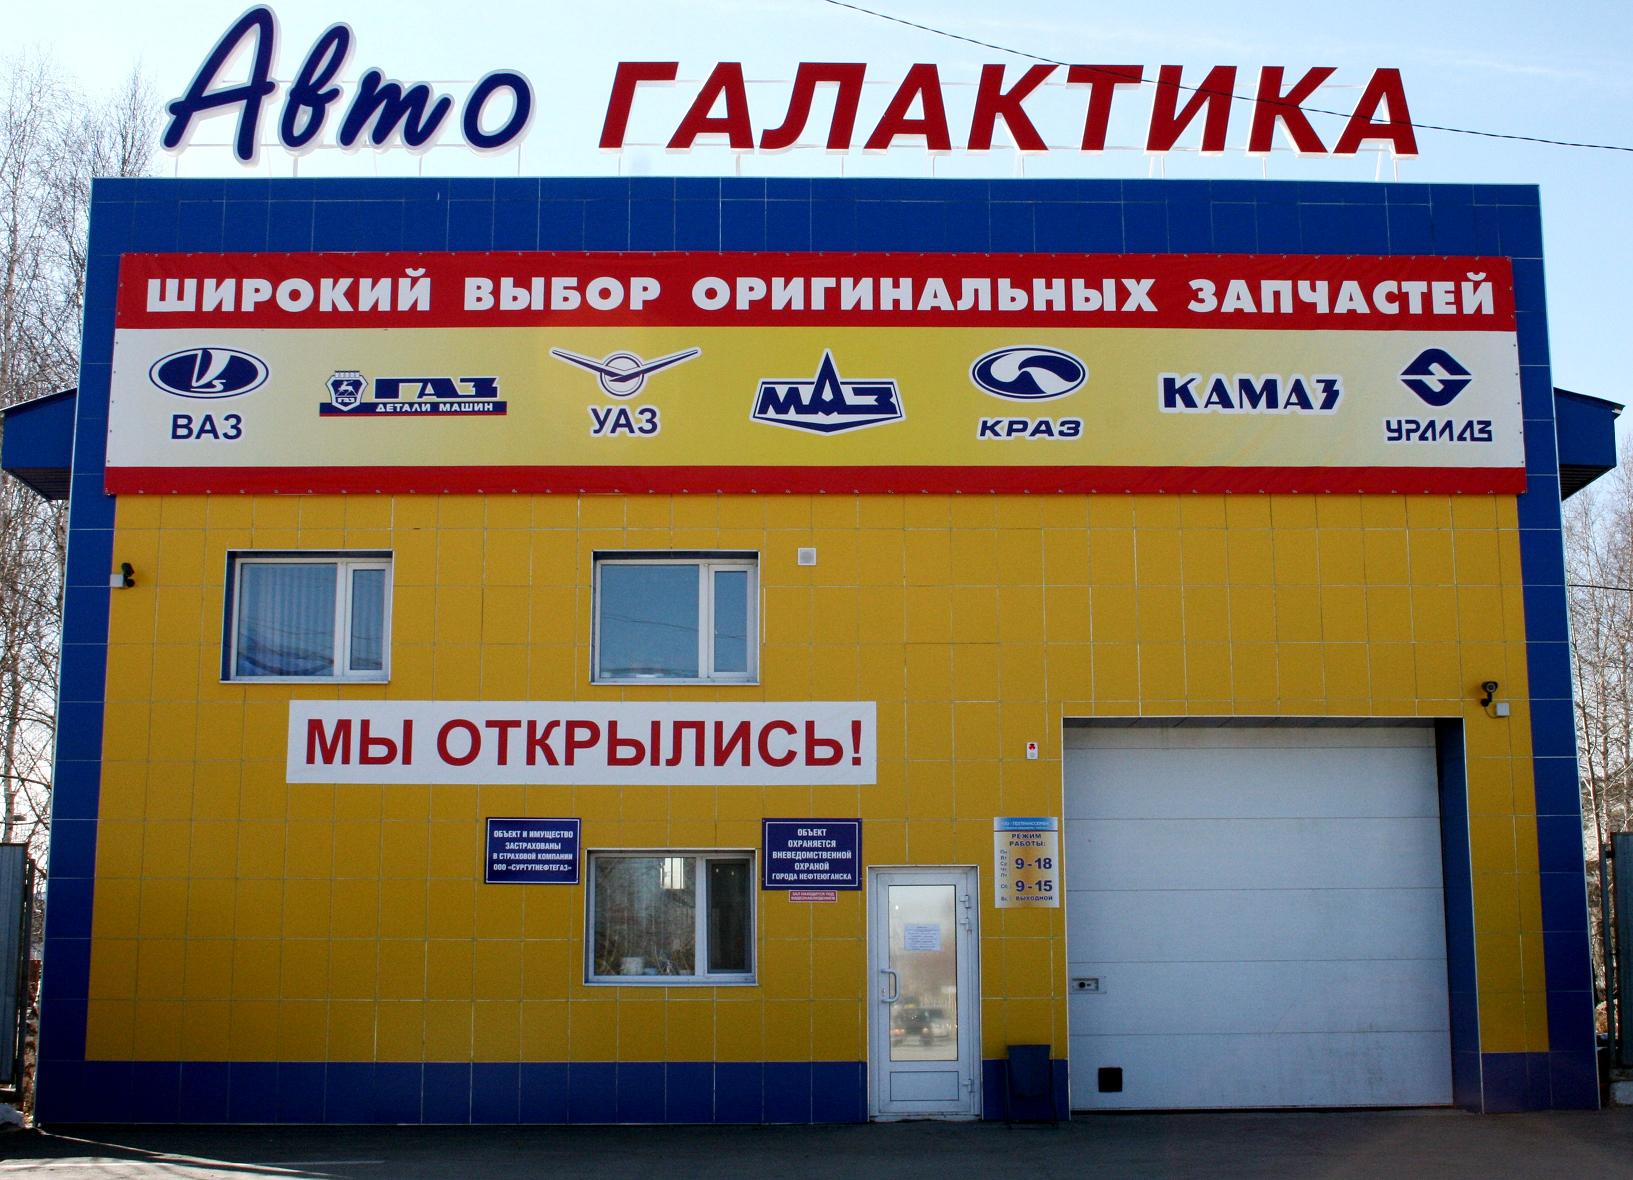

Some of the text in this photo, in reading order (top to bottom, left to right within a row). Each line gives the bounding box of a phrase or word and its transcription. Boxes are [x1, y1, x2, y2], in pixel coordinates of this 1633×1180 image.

[162, 4, 1419, 164] Авто ГАЛАКТИКА
[146, 268, 1496, 316] ШИРОКИЙ ВЫБОР ОРИГИНАЛЬНЫХ ЗАПЧАСТЕЙ
[375, 378, 498, 399] ГАЗ
[757, 352, 898, 416] МАЗ
[1163, 378, 1340, 409] КАМАЗ
[376, 403, 493, 412] ДЕТАЛИ МАШИН
[171, 414, 243, 440] ВАЗ
[591, 408, 658, 434] УАЗ
[980, 420, 1081, 437] КРАЗ
[1386, 419, 1493, 442] УРАЛАЗ
[306, 719, 862, 767] МЫ ОТКРЫЛИСЬ!
[529, 831, 574, 839] ИМУЩЕСТВО
[788, 840, 837, 848] ОХРАНЯЕТСЯ
[499, 852, 536, 860] СТРАХОВОЙ
[505, 842, 561, 850] ЗАСТРАХОВАНЫ
[772, 850, 852, 860] ВНЕВЕДОМСТВЕННОЙ
[794, 862, 830, 870] ОХРАНОЙ
